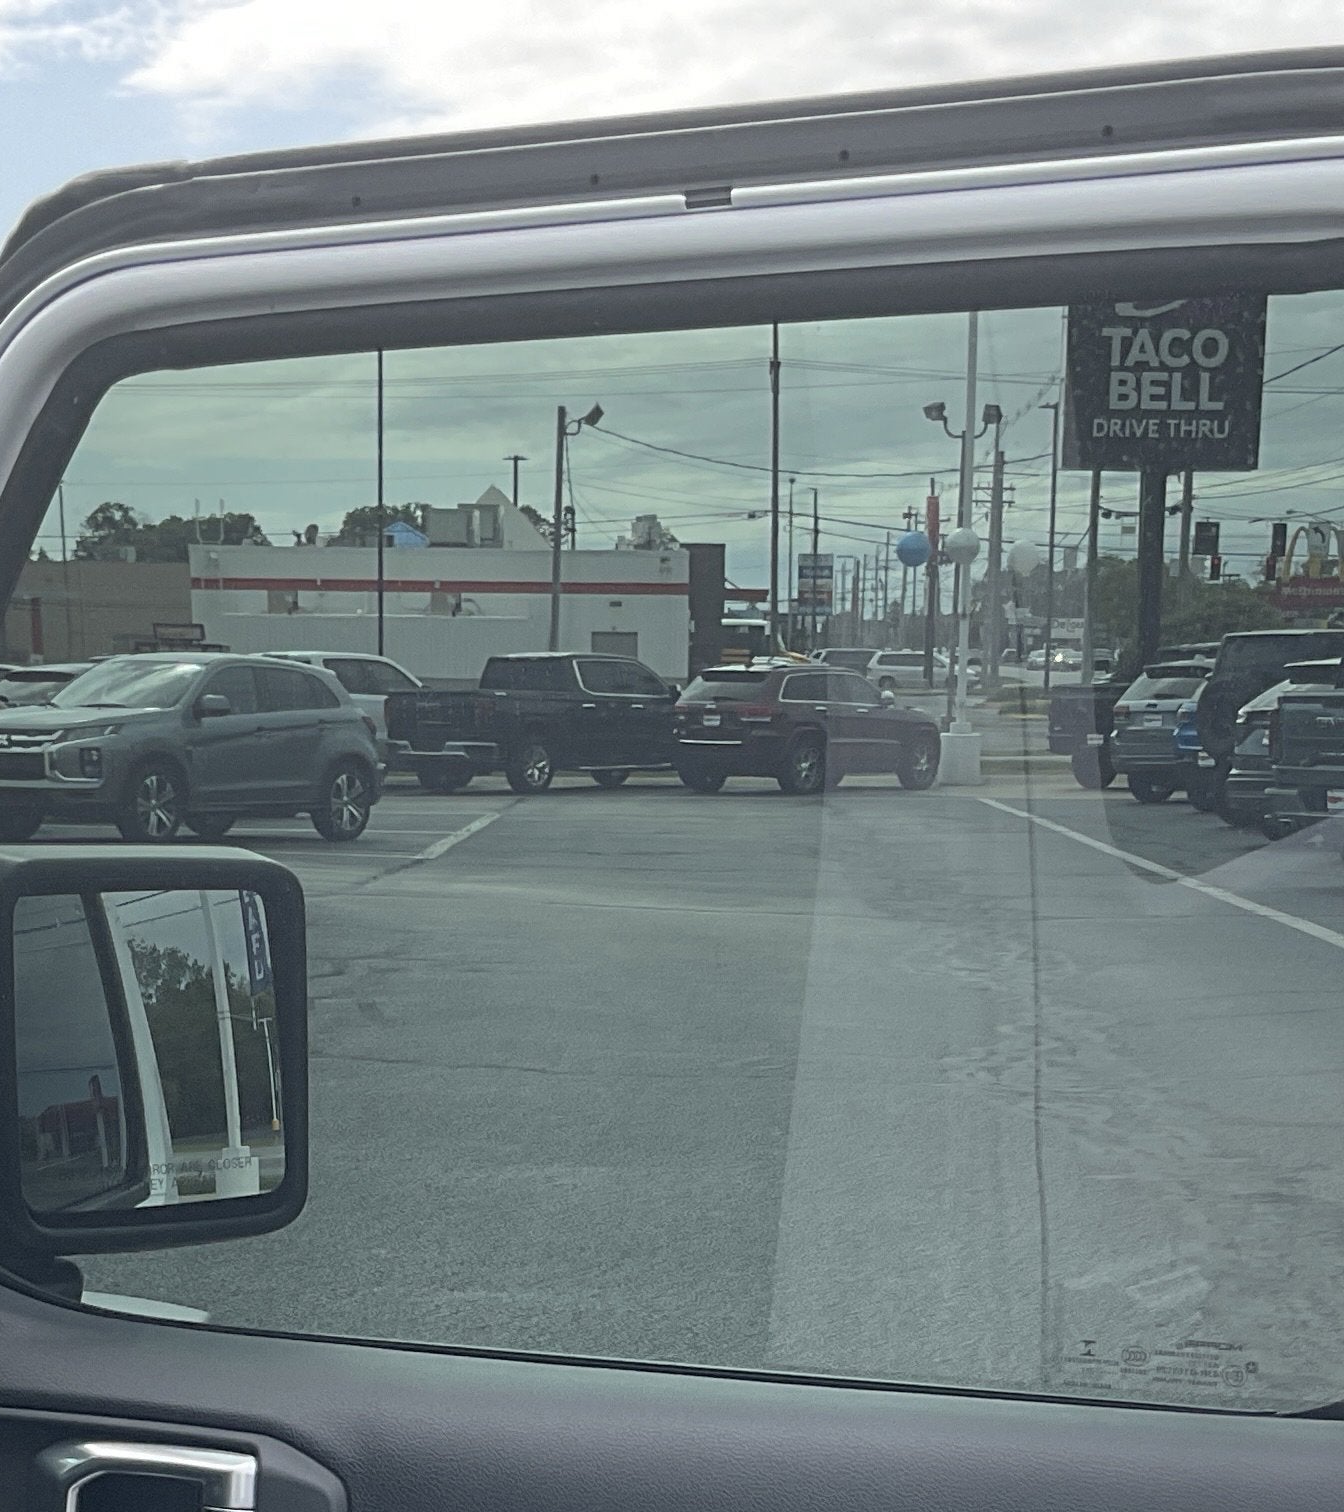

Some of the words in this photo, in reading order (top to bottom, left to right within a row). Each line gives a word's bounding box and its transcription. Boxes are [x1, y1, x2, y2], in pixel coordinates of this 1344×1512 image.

[1102, 328, 1229, 368] TACO
[1109, 371, 1225, 410] BELL
[1092, 418, 1160, 438] DRIVE
[1167, 418, 1229, 438] THRU
[208, 1156, 253, 1171] CLOSER
